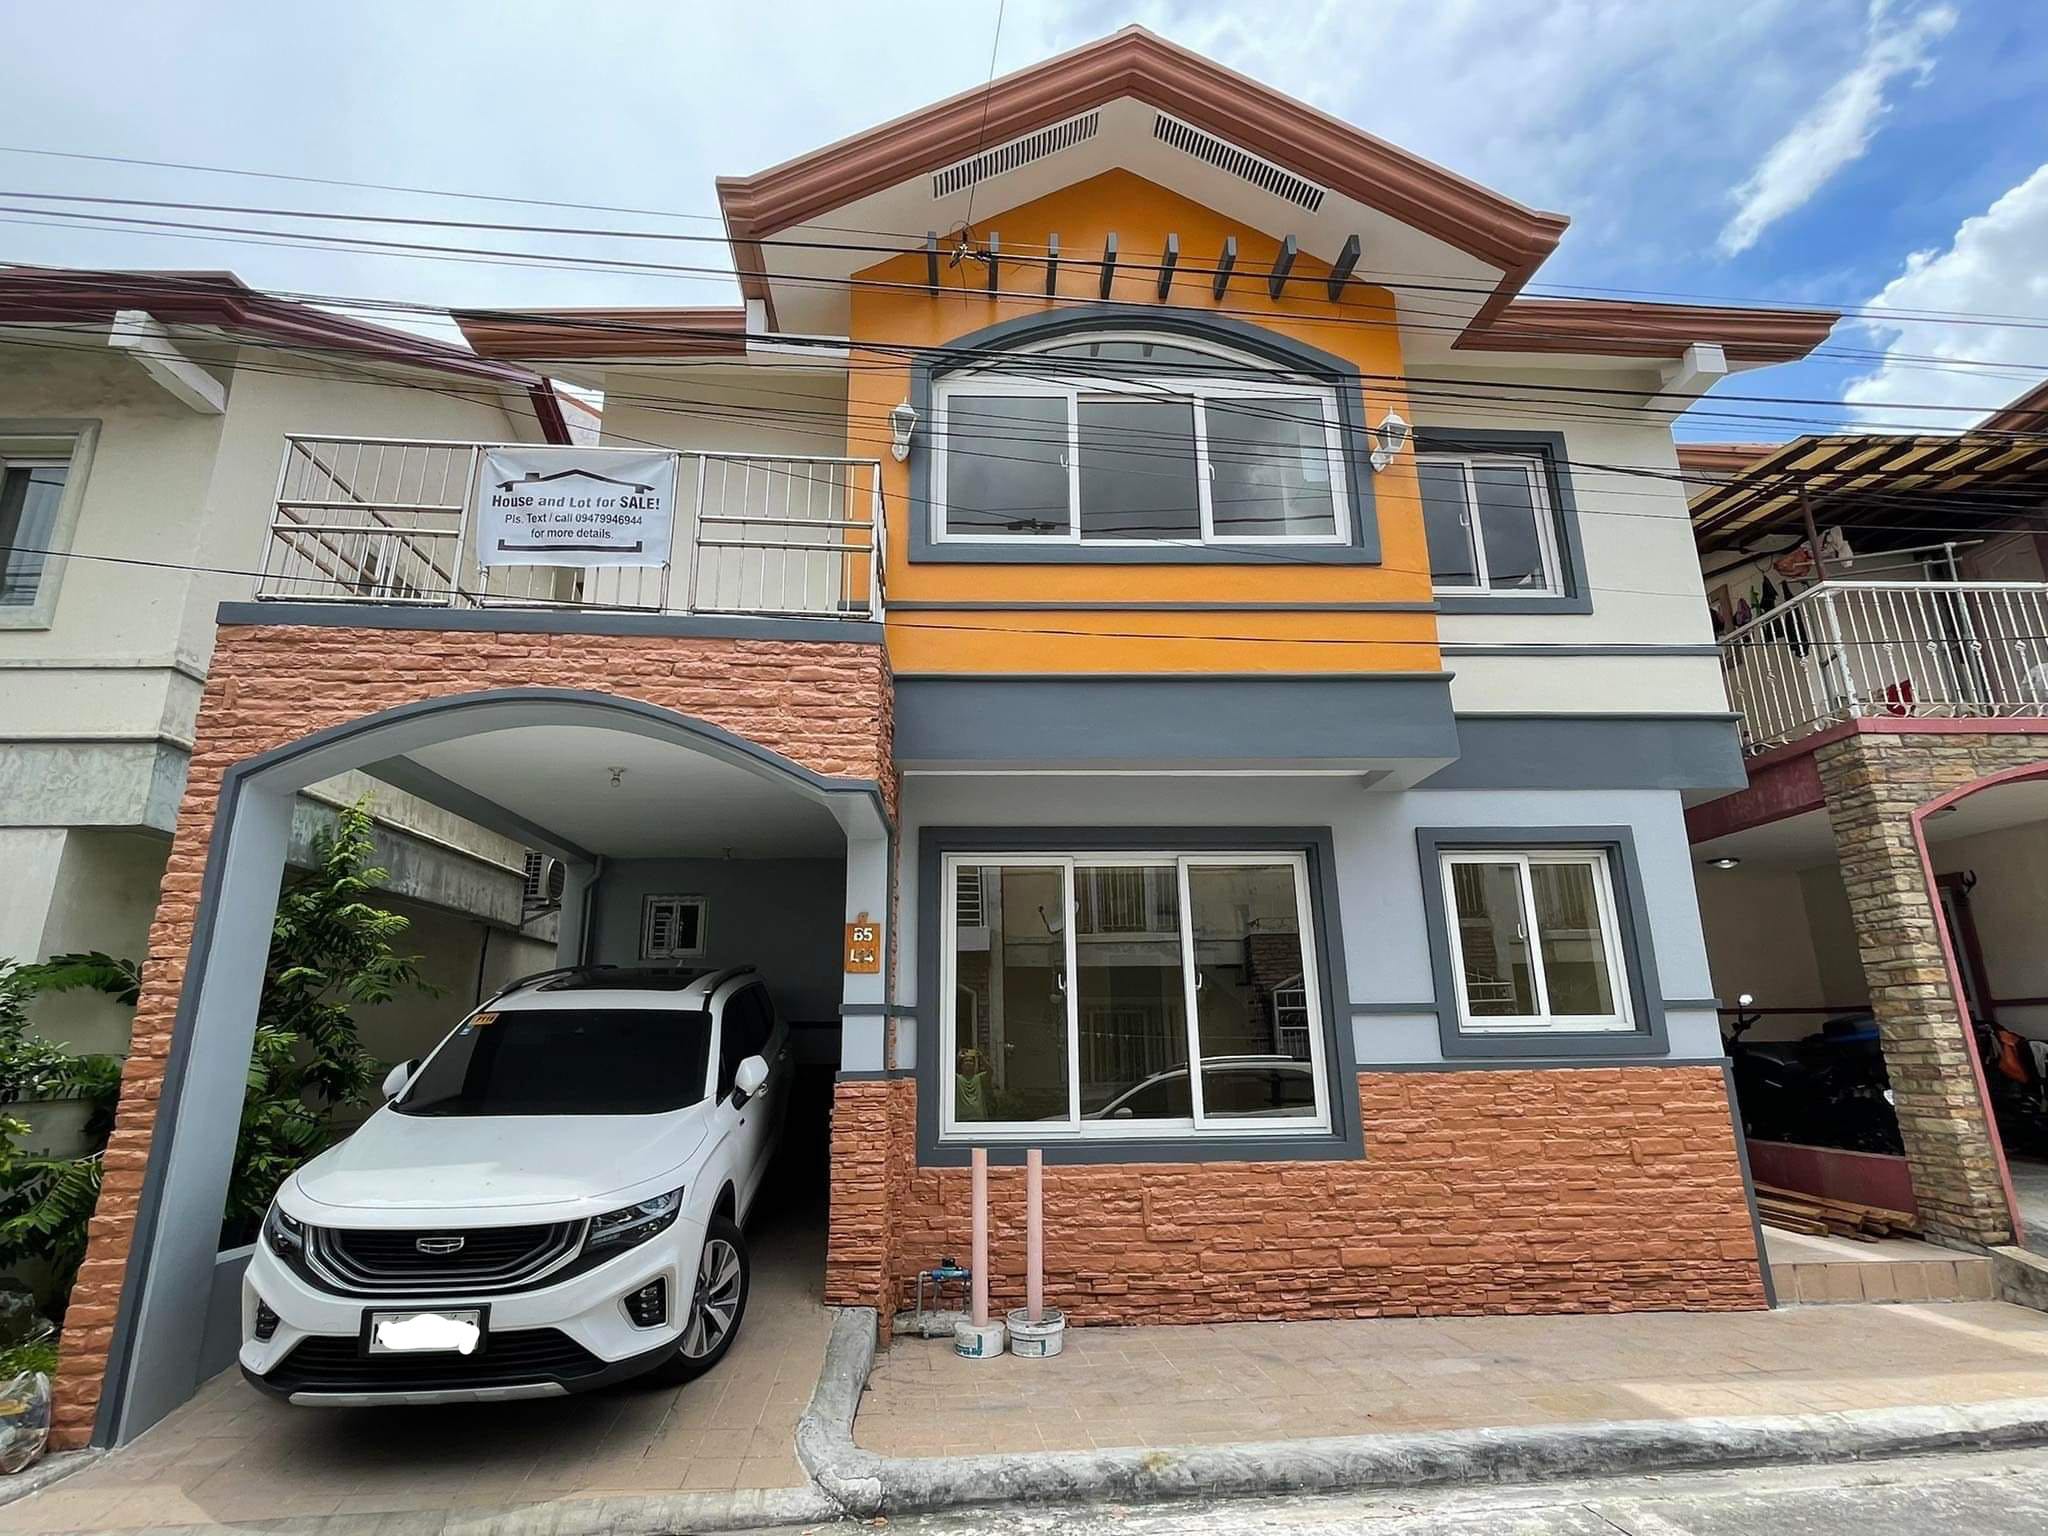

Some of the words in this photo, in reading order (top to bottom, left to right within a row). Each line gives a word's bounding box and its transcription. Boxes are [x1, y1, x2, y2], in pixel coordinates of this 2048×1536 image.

[492, 495, 533, 508] House
[538, 496, 565, 508] and
[569, 496, 591, 508] Lot
[596, 496, 616, 508] for
[619, 496, 660, 510] SALE!
[505, 514, 524, 524] Pls.
[527, 513, 547, 523] Text
[554, 513, 573, 523] call
[575, 513, 642, 525] 09479946944
[531, 529, 545, 539] for
[547, 530, 574, 538] more
[576, 529, 614, 540] details.
